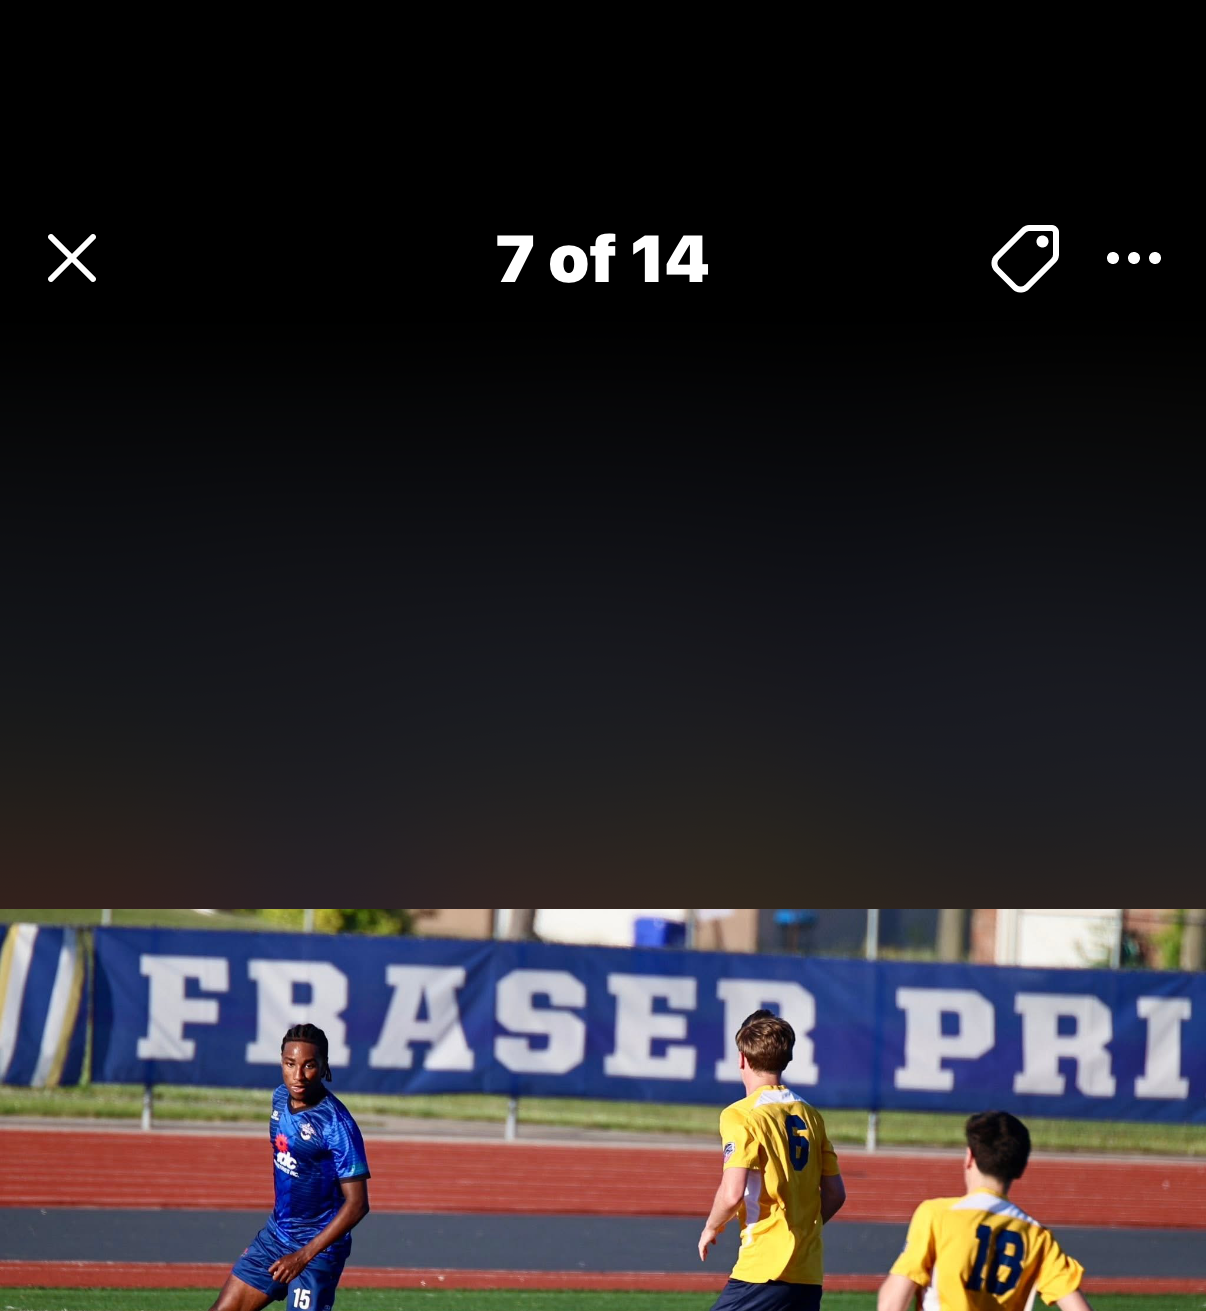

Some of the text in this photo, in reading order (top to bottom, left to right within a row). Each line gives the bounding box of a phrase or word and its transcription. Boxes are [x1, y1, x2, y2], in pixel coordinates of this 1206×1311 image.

[136, 954, 1192, 1100] FRASER PRI
[785, 1114, 810, 1172] 6
[966, 1224, 1025, 1296] 18
[293, 1287, 311, 1310] 15
